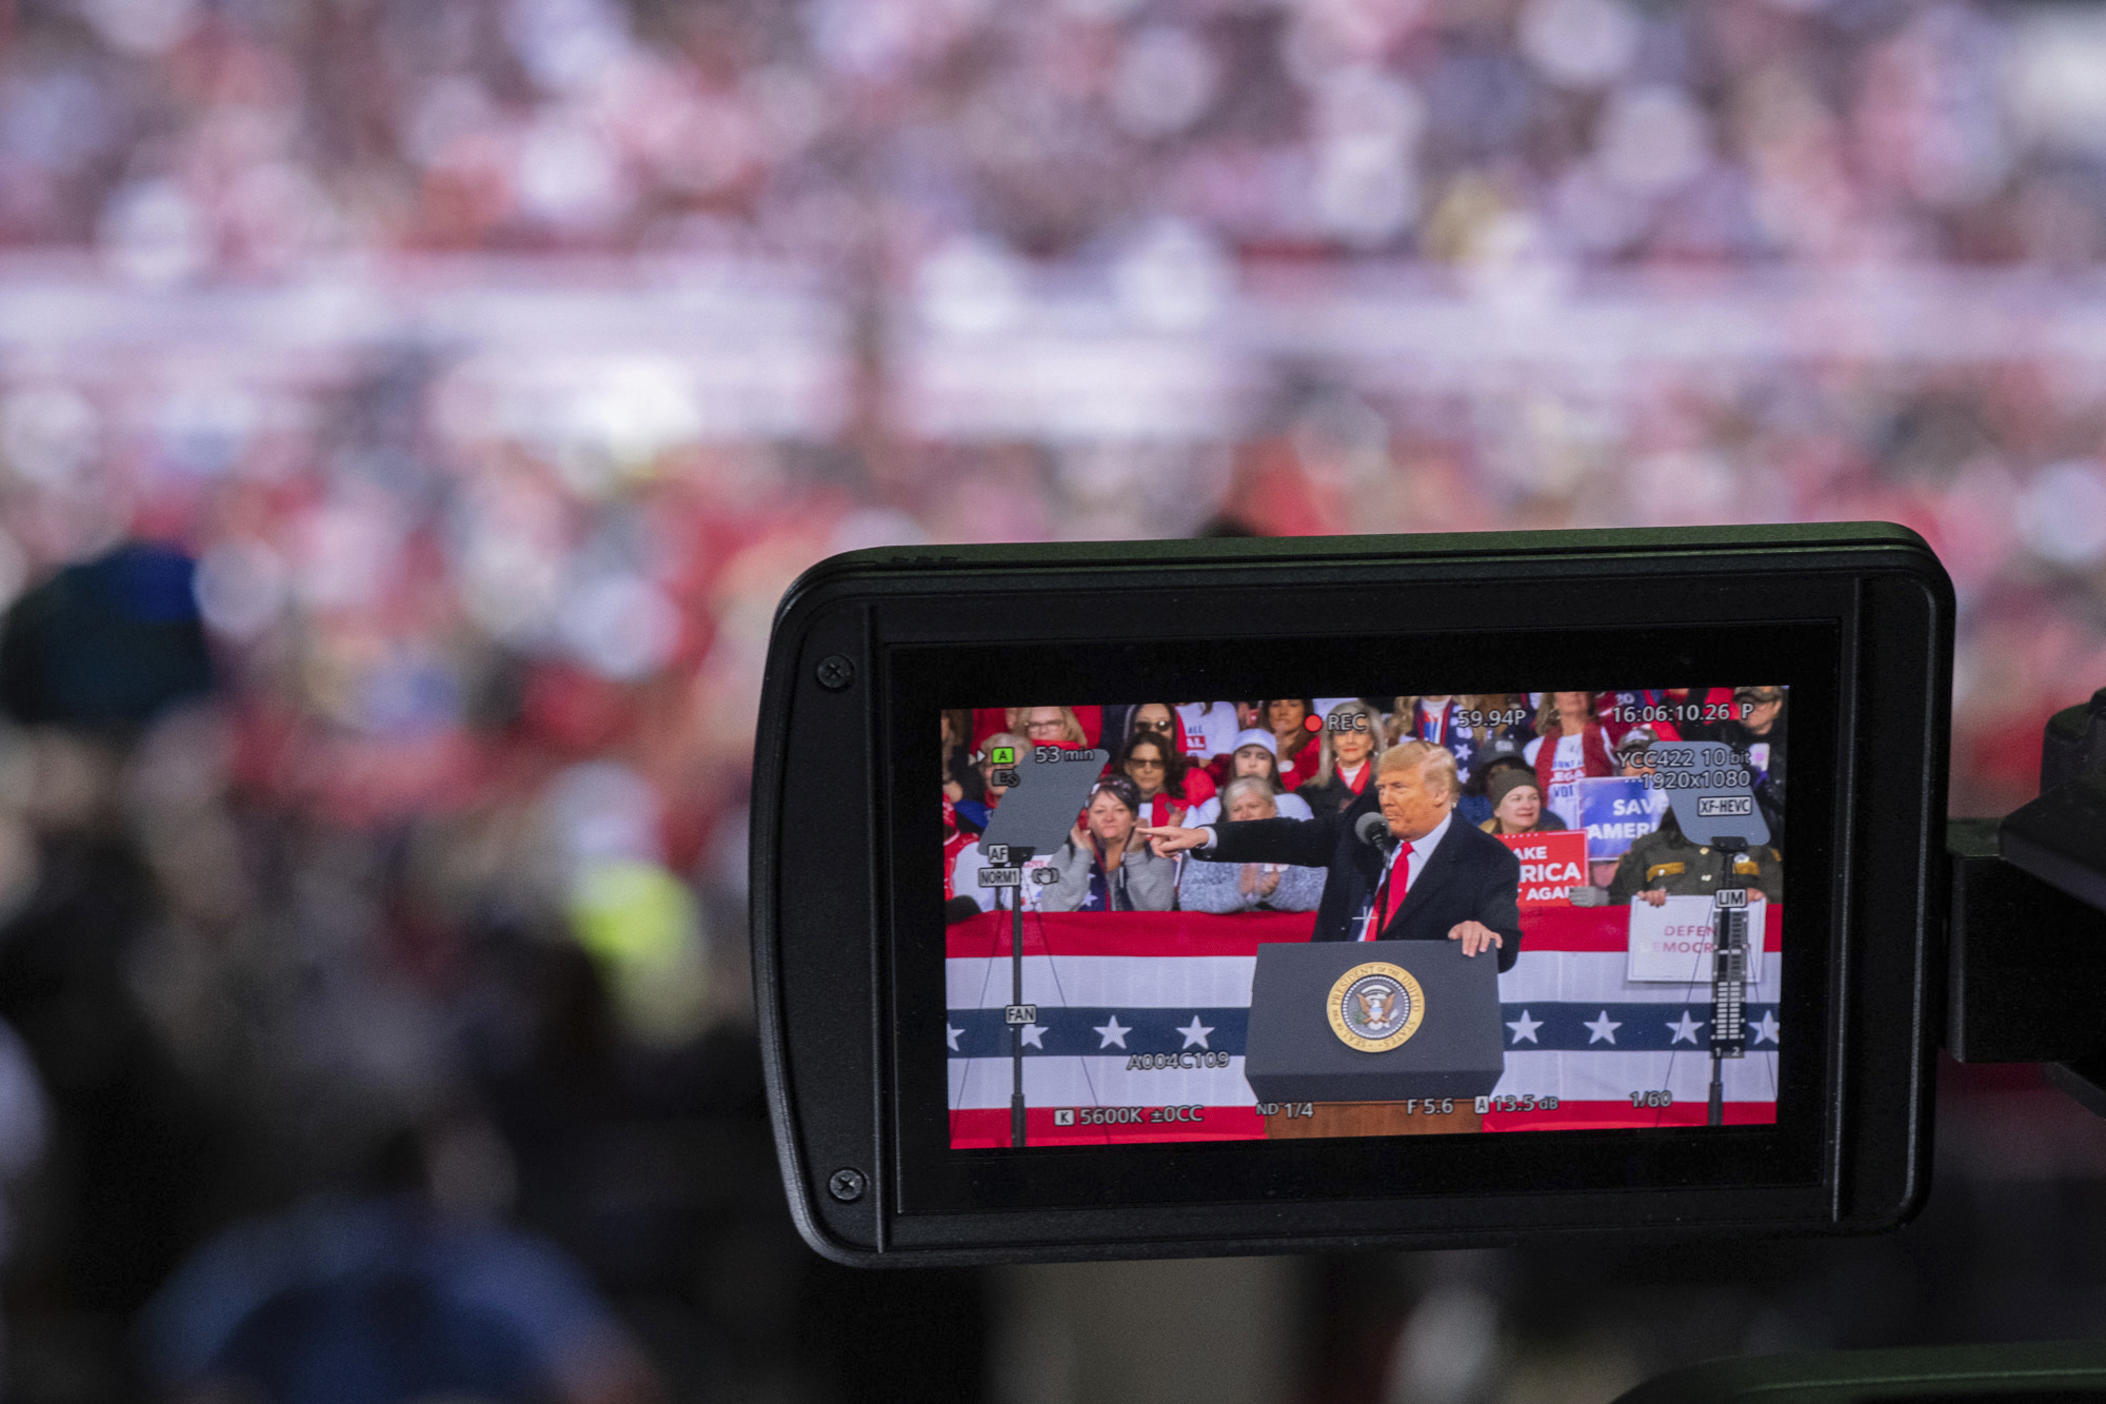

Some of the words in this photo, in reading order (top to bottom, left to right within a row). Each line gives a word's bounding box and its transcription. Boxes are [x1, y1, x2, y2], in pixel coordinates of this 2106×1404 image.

[1457, 709, 1527, 727] 59.94P
[1613, 703, 1731, 723] 16:06:10.26
[1741, 703, 1754, 720] P
[1328, 713, 1368, 732] REC
[1035, 745, 1060, 764] 53
[1065, 750, 1095, 762] min
[1617, 749, 1695, 768] YCC422
[1702, 748, 1727, 766] 10
[1730, 751, 1751, 766] bit
[1641, 770, 1751, 790] 1920x1080
[1701, 798, 1750, 814] XF-HEVC
[1588, 821, 1658, 840] AMERI
[990, 846, 1008, 860] AF
[1513, 845, 1548, 860] AKE
[981, 870, 1018, 884] NORM1
[1519, 861, 1582, 883] RICA
[1526, 886, 1572, 901] AGAI
[1664, 925, 1718, 937] DEFEN
[1008, 1008, 1034, 1022] FAN
[1127, 1051, 1230, 1070] A004C109
[1407, 1098, 1418, 1114] F
[1424, 1097, 1454, 1115] 5.6
[1494, 1094, 1535, 1113] 13.5
[1538, 1095, 1559, 1111] dB
[1629, 1090, 1673, 1108] 1/60
[1080, 1107, 1143, 1125] 5600K
[1150, 1105, 1204, 1123] ±0CC
[1255, 1103, 1279, 1116] ND
[1284, 1103, 1314, 1119] 1/4
